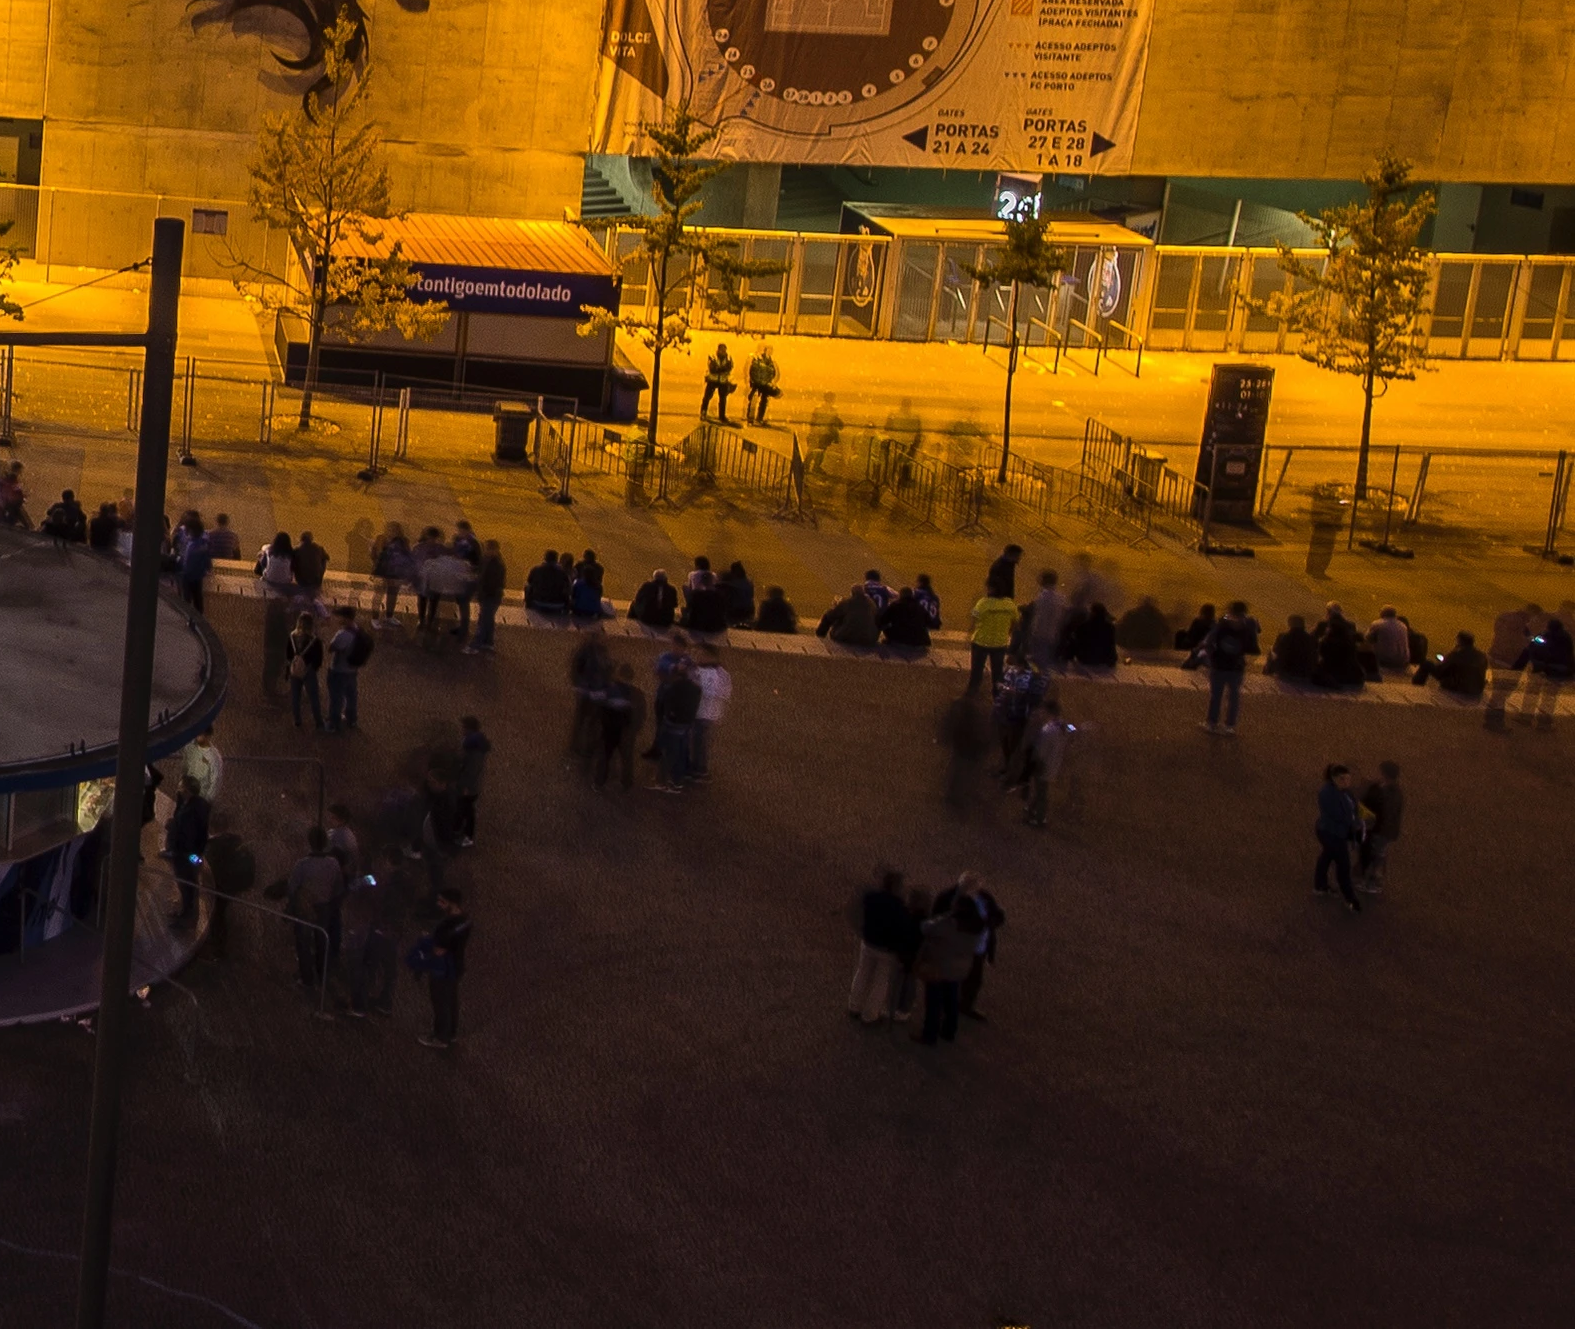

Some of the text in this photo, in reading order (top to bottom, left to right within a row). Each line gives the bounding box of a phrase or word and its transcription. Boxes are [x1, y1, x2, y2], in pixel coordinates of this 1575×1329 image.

[1040, 7, 1138, 18] ADEPTOS VISITANTES
[1075, 18, 1123, 29] FECHADA)
[610, 31, 652, 44] DOLCE
[609, 45, 636, 58] VITA
[1035, 41, 1116, 52] ACESSO ADEPTOS
[1034, 52, 1081, 62] VISITANTE
[1031, 71, 1113, 81] ACESSO ADEPTOS
[1030, 81, 1075, 91] FC PORTO
[937, 108, 965, 117] GATES
[1025, 107, 1053, 116] GATES
[934, 123, 999, 139] PORTAS
[1023, 118, 1087, 133] PORTAS
[932, 140, 990, 155] 21 A 24
[1028, 136, 1085, 150] 27 E 28
[1036, 153, 1083, 167] 1 A 18
